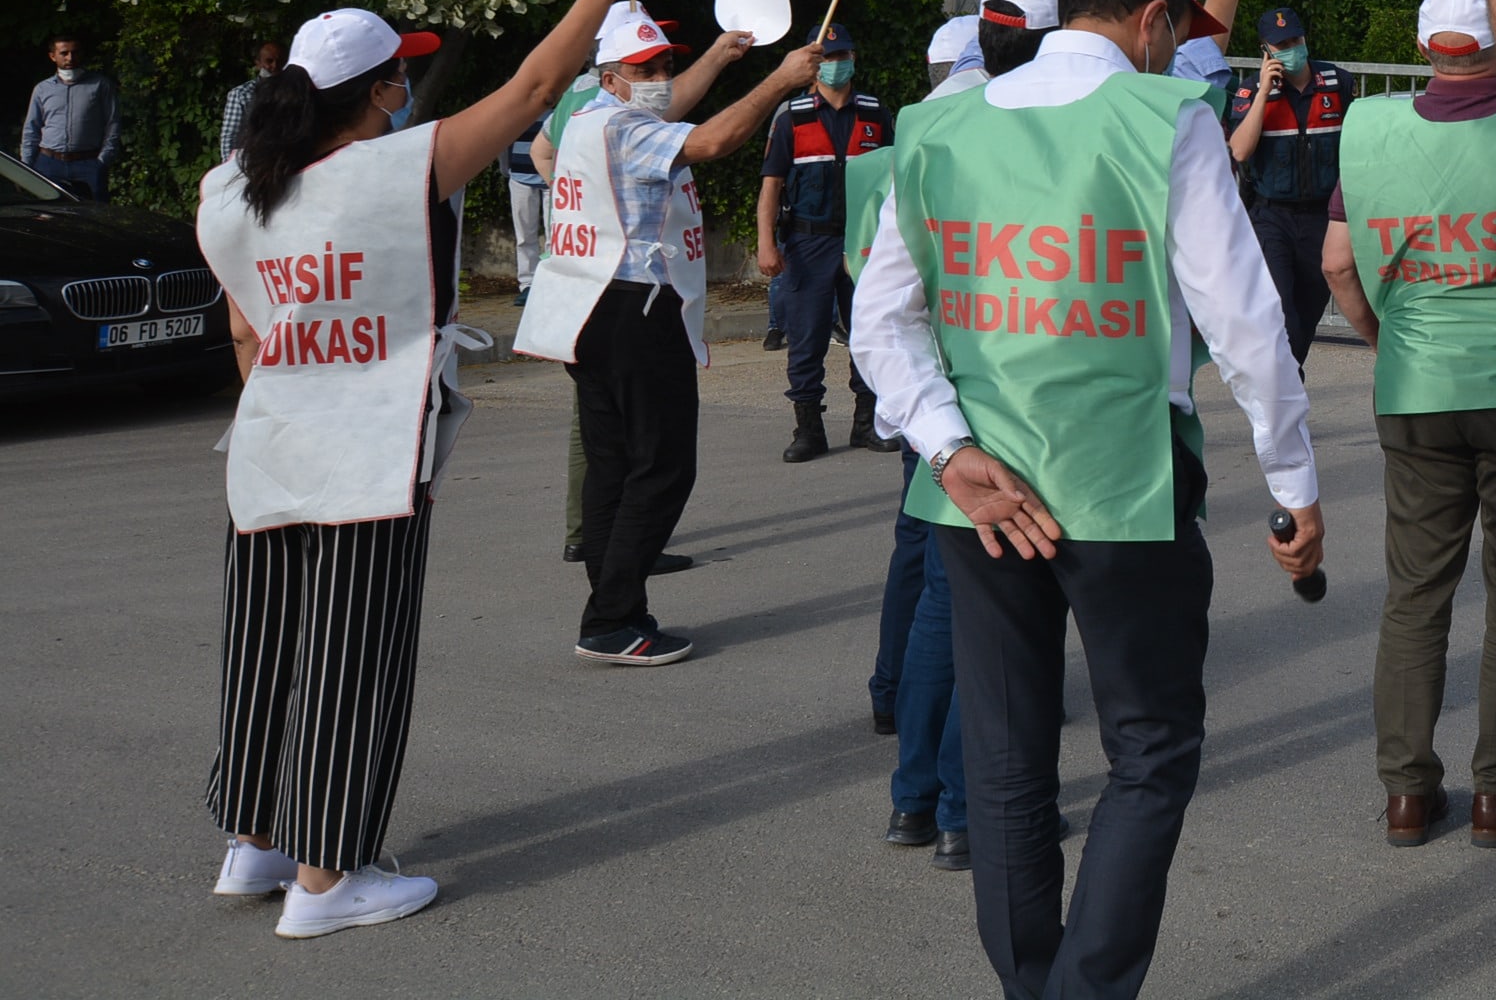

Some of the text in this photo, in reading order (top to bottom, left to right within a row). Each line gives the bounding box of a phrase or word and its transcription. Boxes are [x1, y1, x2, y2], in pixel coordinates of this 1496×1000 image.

[550, 170, 583, 211] SİF
[256, 241, 364, 305] TEKSİF
[109, 325, 129, 344] 06
[139, 321, 158, 341] FD
[165, 315, 201, 337] 5207
[938, 286, 1146, 338] ENDİKASI
[252, 310, 388, 367] DİKASI
